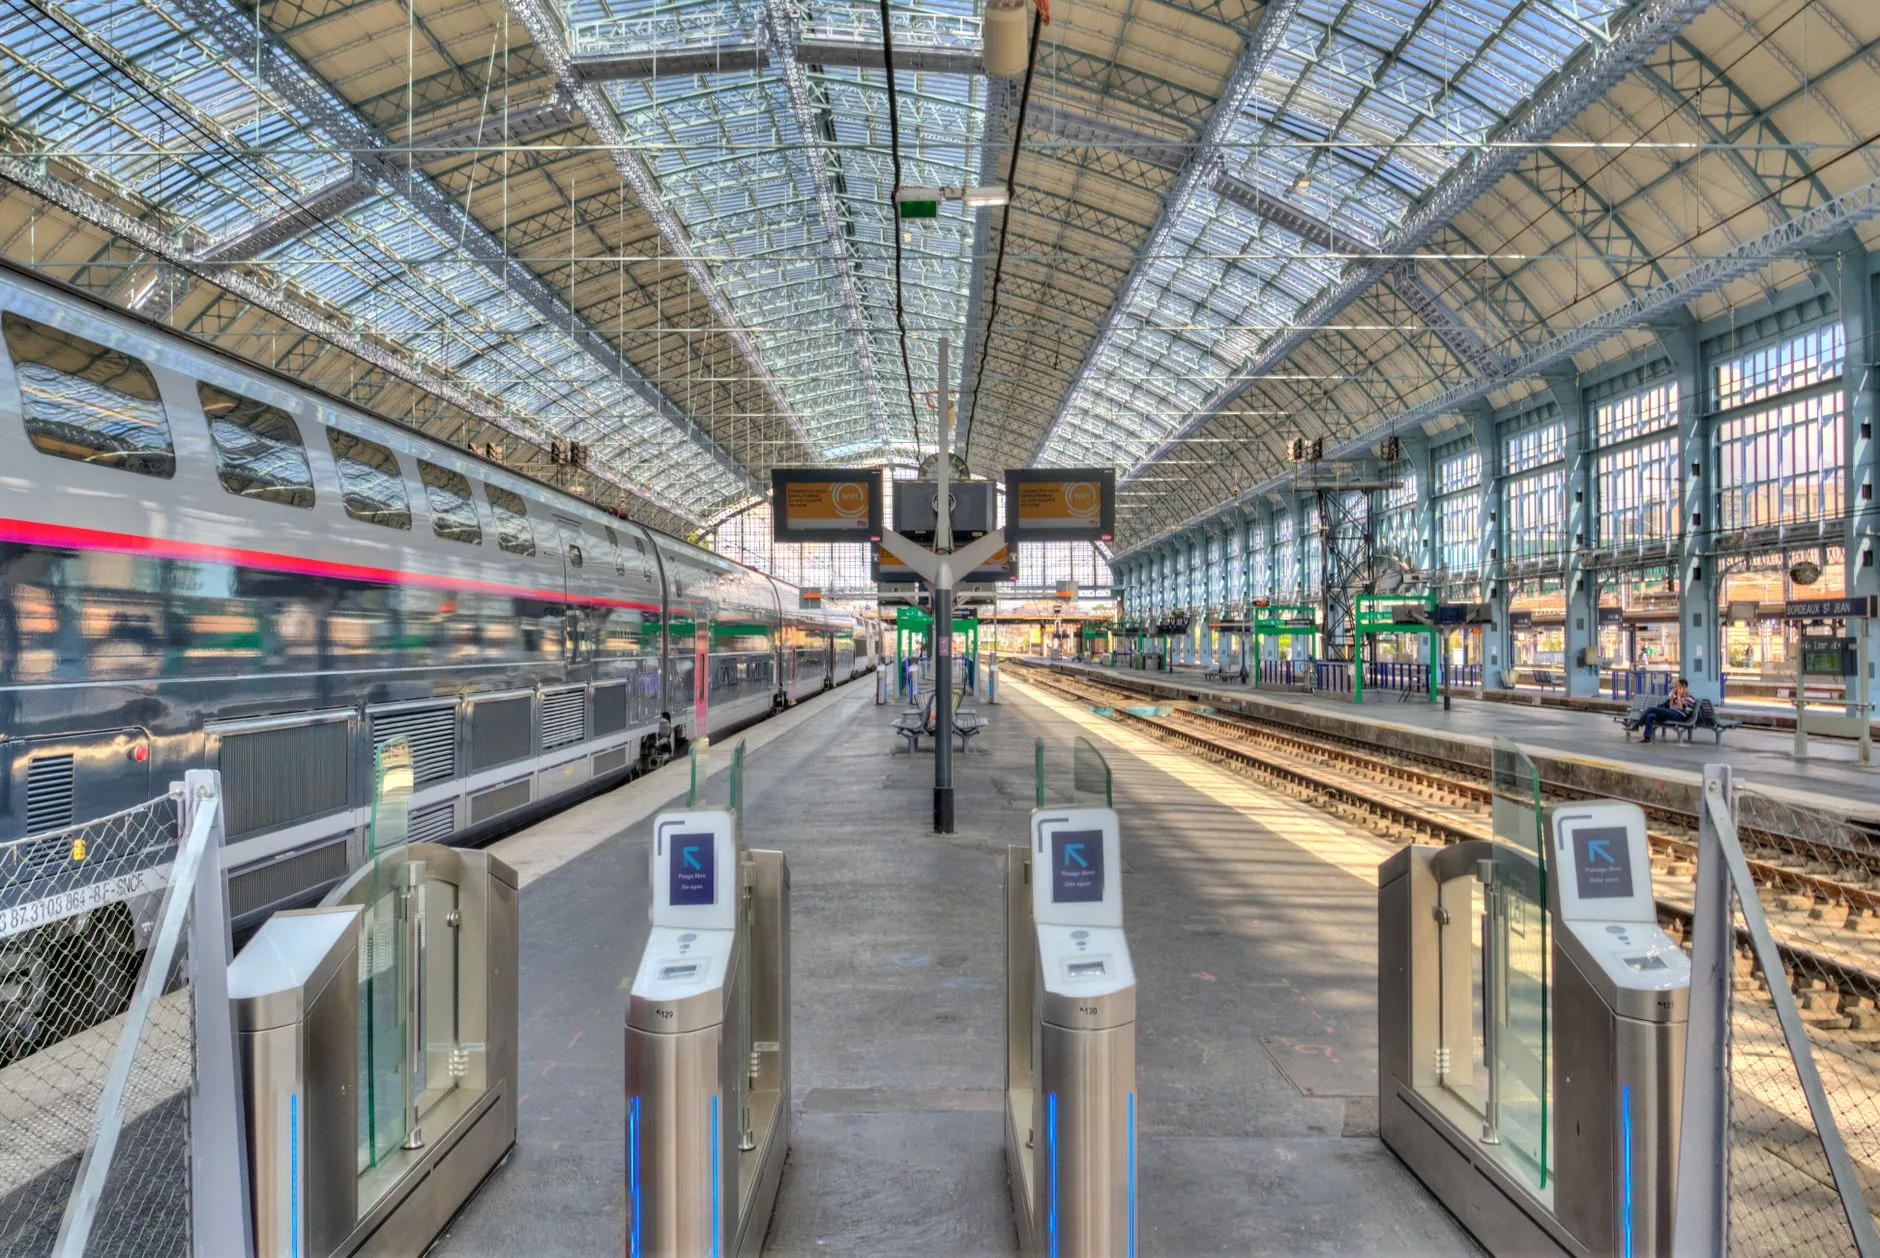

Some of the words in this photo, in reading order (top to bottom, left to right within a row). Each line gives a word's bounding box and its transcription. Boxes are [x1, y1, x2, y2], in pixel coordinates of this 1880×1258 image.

[1786, 604, 1820, 615] BORDEAUX
[1833, 602, 1851, 614] JEAN
[10, 906, 27, 924] 87
[31, 897, 63, 920] 3103
[661, 1010, 674, 1019] 129
